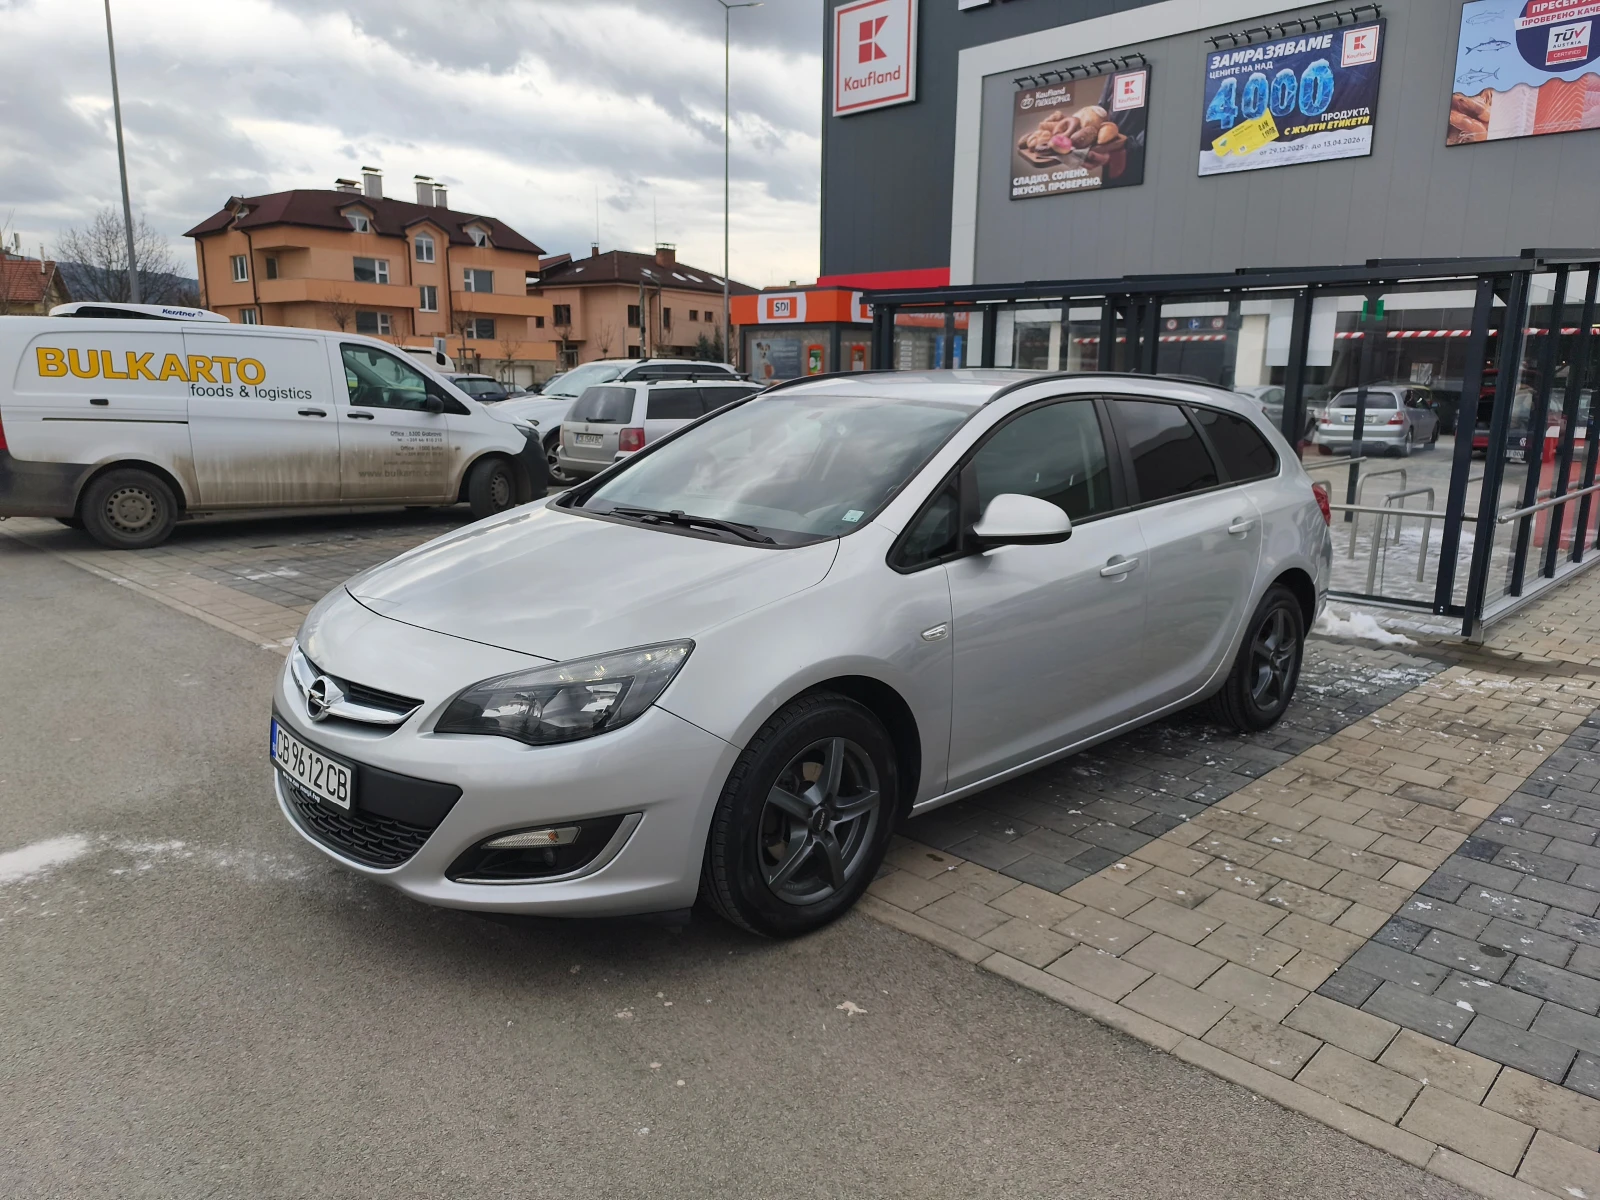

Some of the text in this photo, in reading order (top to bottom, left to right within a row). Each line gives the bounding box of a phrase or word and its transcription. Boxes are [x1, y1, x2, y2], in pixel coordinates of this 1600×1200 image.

[1522, 11, 1575, 26] ПРОВЕРЕНО
[1210, 34, 1333, 69] ЗАМРАЗЯВАМЕ
[1346, 50, 1372, 59] Kaufland
[1553, 50, 1582, 58] CERTIFIED
[844, 65, 901, 91] Kaufland
[1210, 61, 1274, 79] ЦЕНИТЕ НА НАД
[1036, 87, 1065, 99] Kaufland
[1206, 58, 1334, 129] 4000
[1322, 107, 1370, 121] ПРОДУКТА
[1291, 122, 1326, 134] ЖЪЛТИ
[1327, 116, 1370, 130] ЕТИКЕТИ
[1013, 168, 1089, 186] СЛАДКО. СОЛЕНО.
[1012, 177, 1102, 196] ВКУСНО. ПРОВЕРЕНО.
[162, 308, 196, 317] Kerstner
[775, 302, 788, 312] SDI
[36, 346, 266, 386] BULKARTO
[190, 384, 312, 402] foods & logistics
